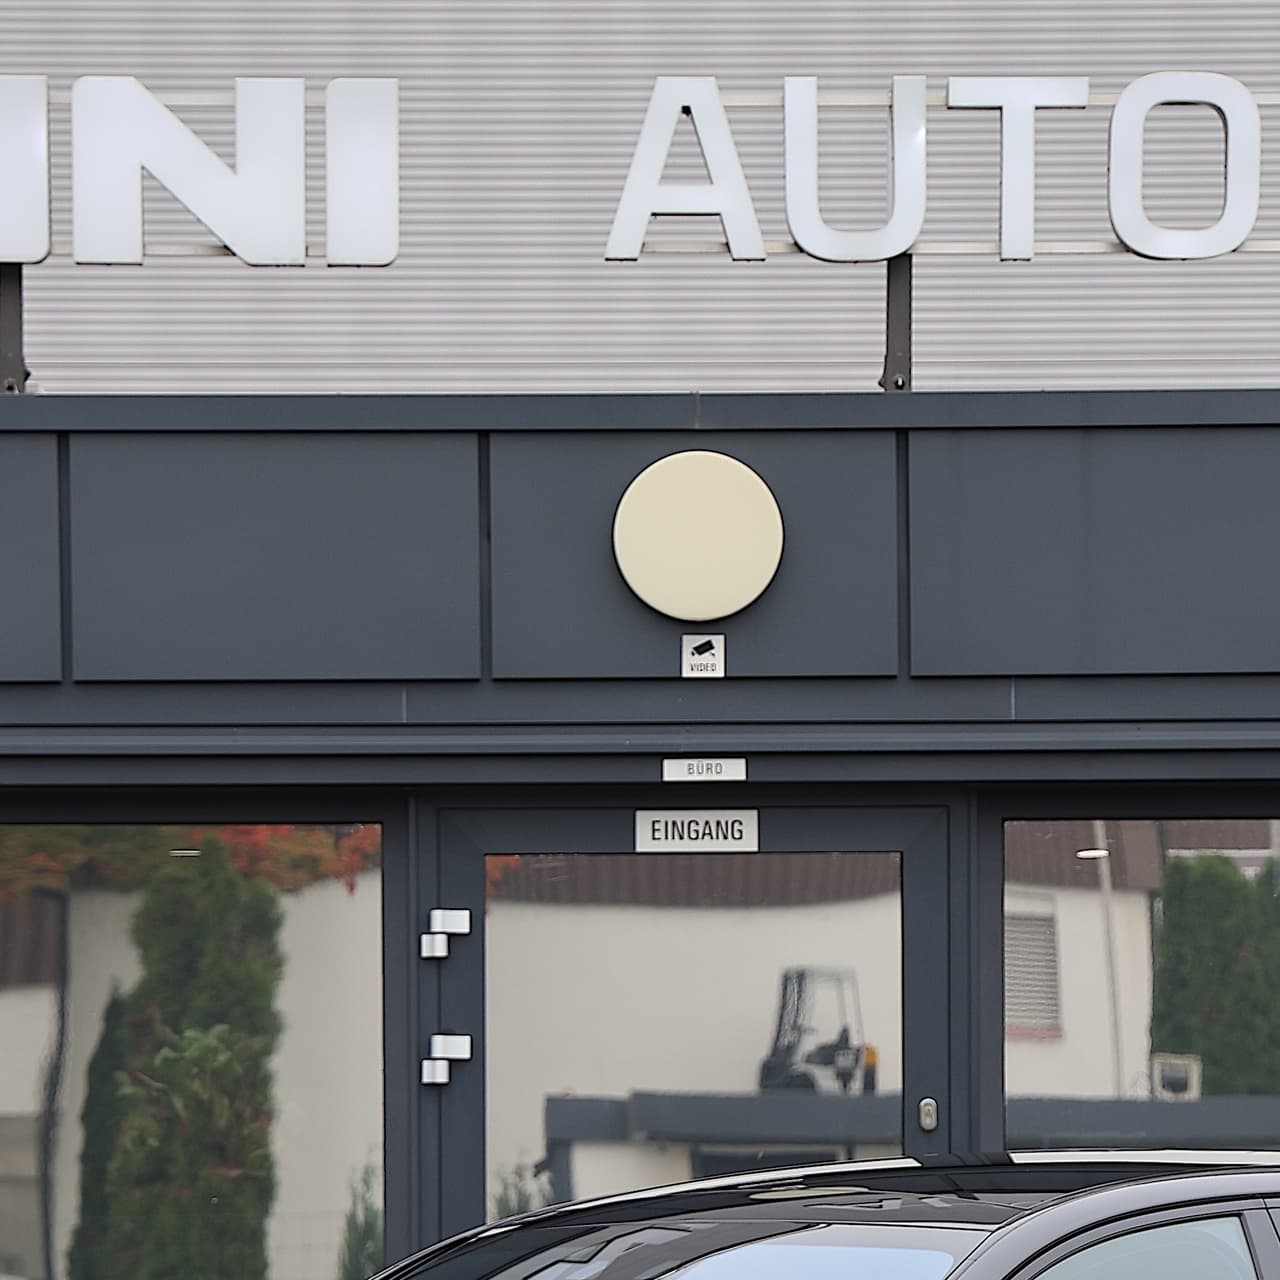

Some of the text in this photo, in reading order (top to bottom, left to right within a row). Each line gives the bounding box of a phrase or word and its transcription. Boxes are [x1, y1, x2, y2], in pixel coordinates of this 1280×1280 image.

[605, 70, 1262, 263] AUTO
[689, 662, 717, 672] VIDEO
[687, 760, 723, 775] BÜRO
[651, 819, 744, 841] EINGANG
